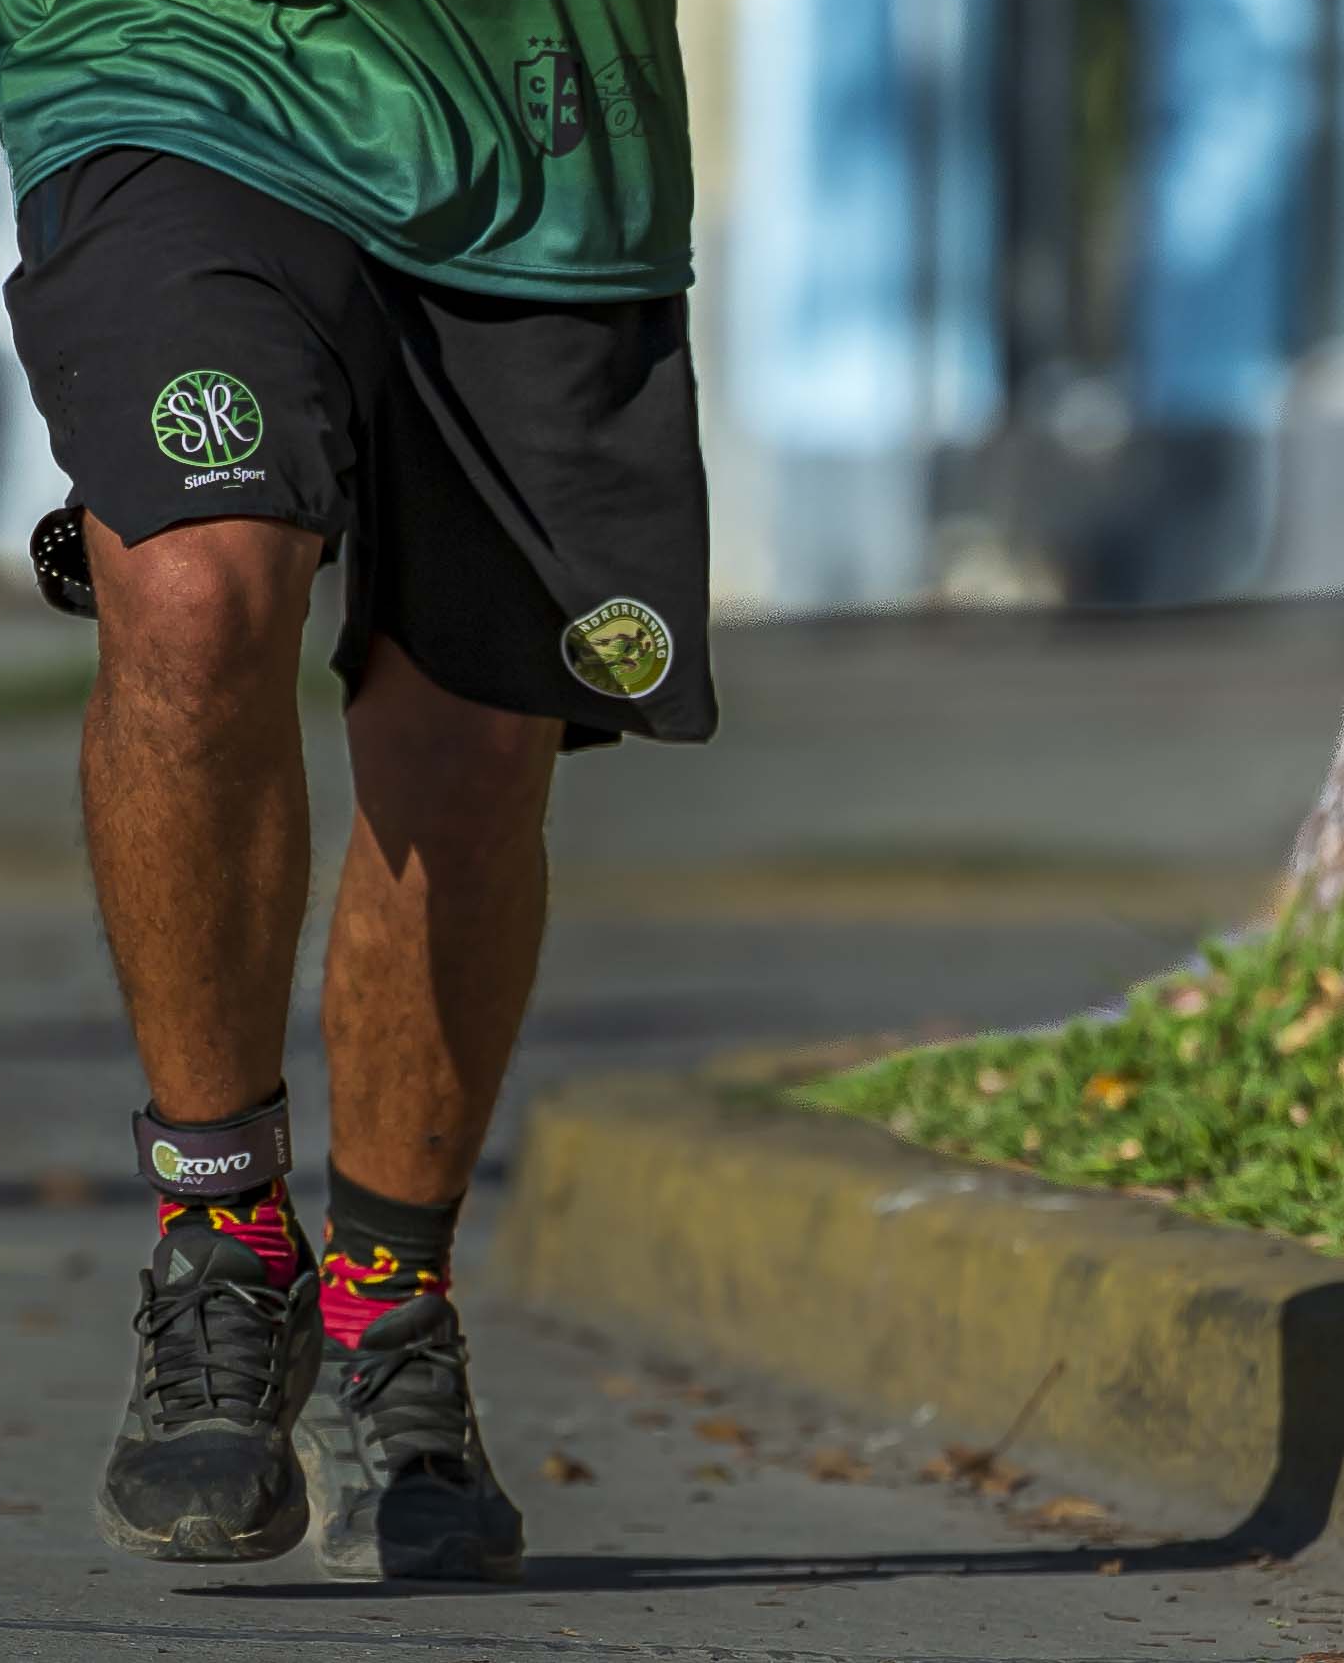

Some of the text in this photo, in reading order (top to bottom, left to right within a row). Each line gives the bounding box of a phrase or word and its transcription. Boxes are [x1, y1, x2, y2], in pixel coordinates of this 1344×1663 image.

[529, 76, 577, 96] C A
[528, 102, 548, 121] W
[560, 106, 577, 125] K
[168, 384, 254, 452] SR
[184, 467, 265, 490] Sindro Sport
